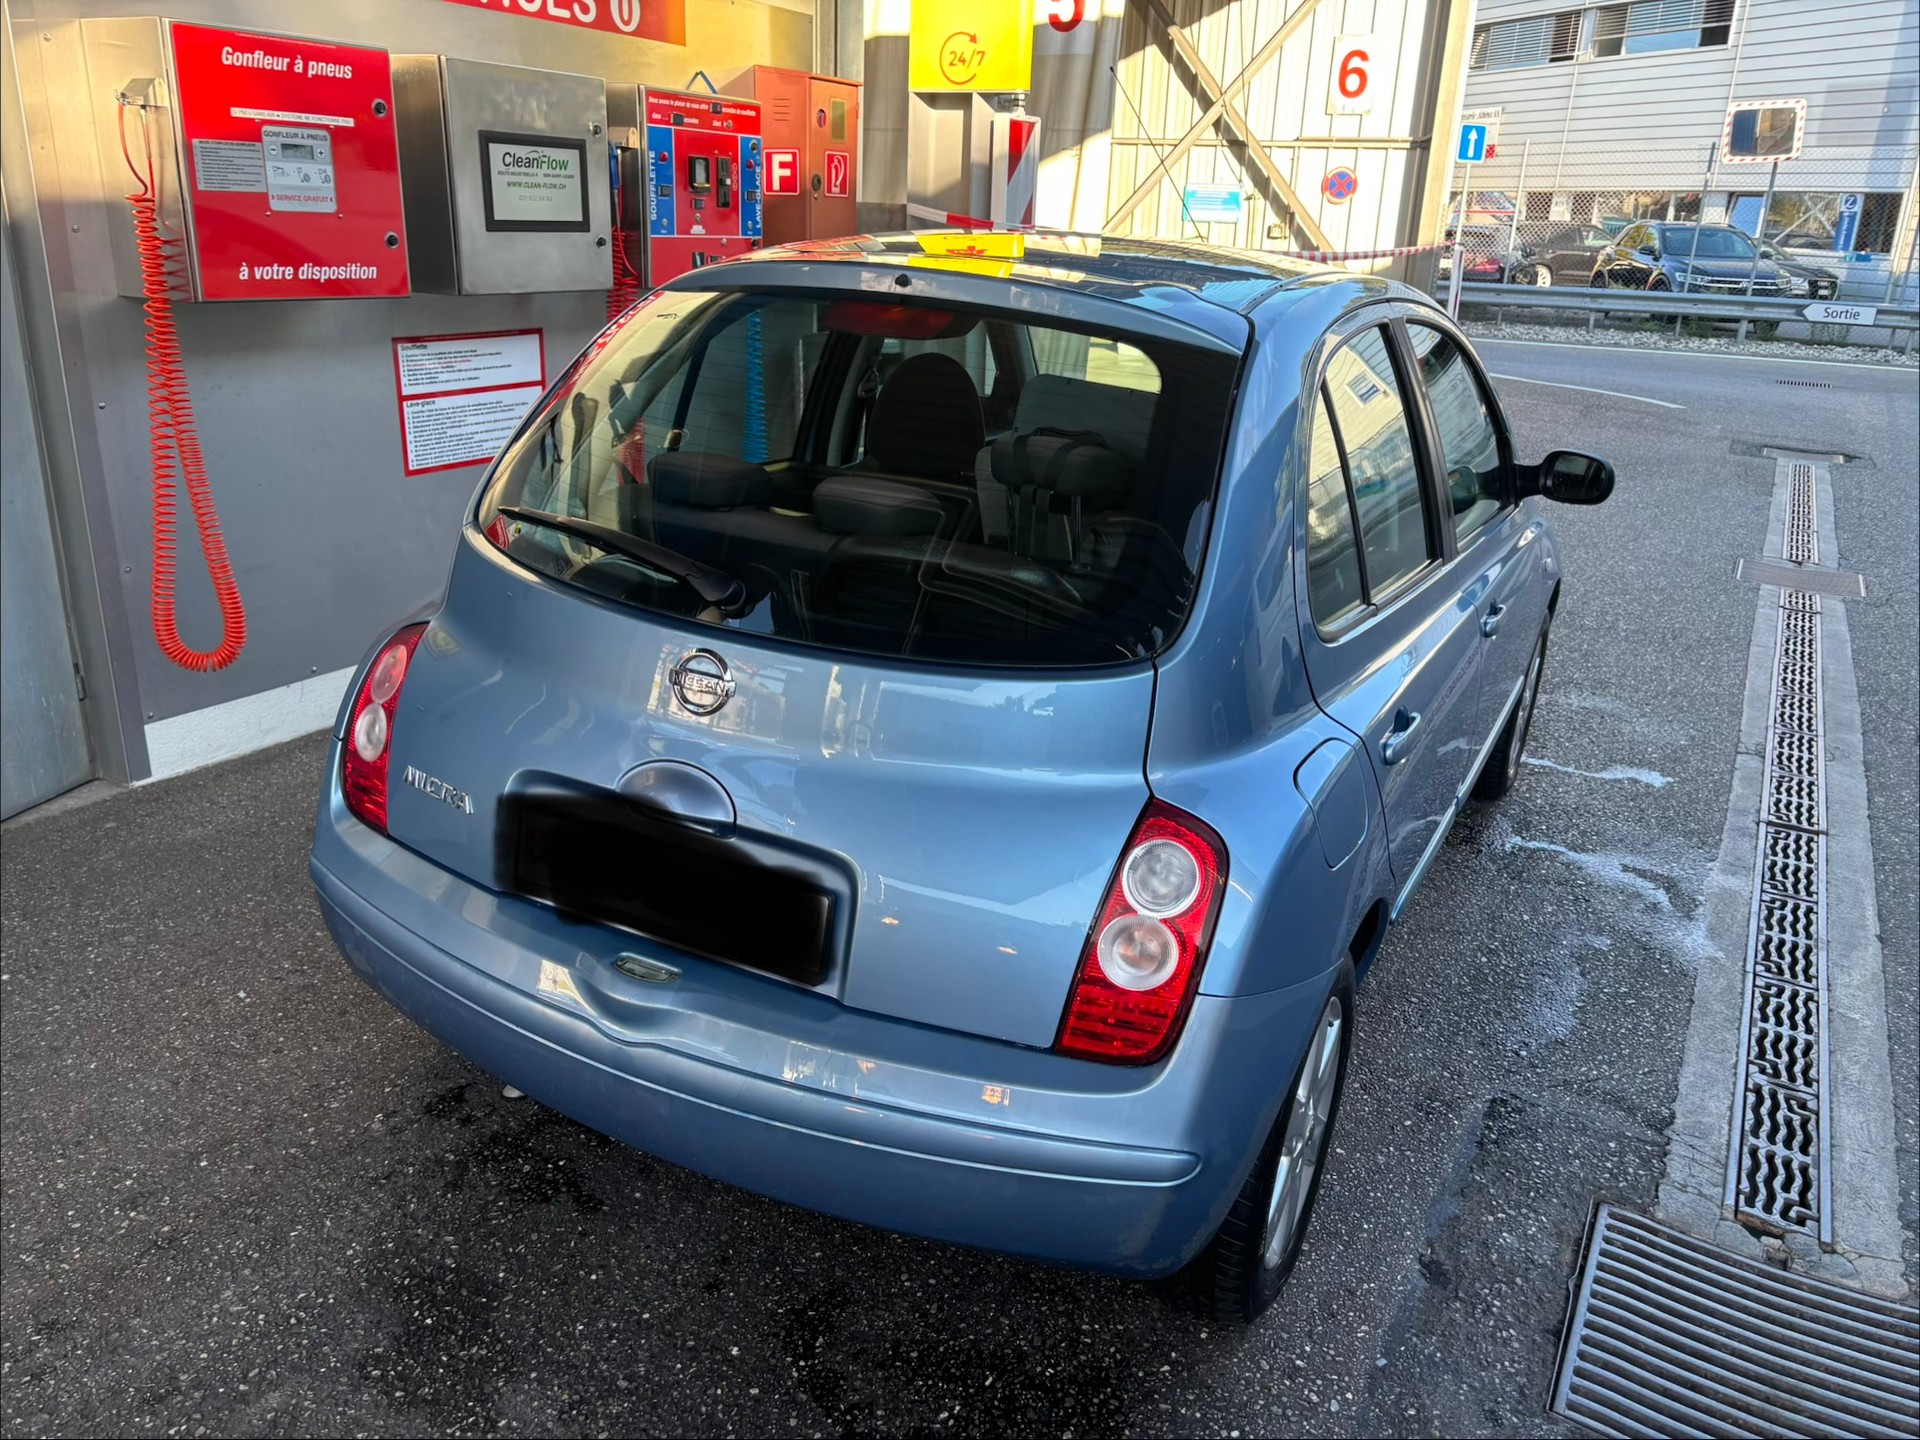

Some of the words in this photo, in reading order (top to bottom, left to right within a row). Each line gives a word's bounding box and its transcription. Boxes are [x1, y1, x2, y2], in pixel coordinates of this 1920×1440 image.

[221, 46, 290, 72] Gonfleur
[293, 54, 303, 73] à
[307, 60, 353, 79] pneus
[948, 48, 986, 69] 24/7
[1338, 49, 1369, 99] 6
[263, 130, 300, 140] GONFLEUR
[307, 133, 328, 142] PNEUS
[502, 152, 569, 171] CleanFlow
[772, 154, 792, 191] F
[507, 182, 566, 190] WWW.CLEAN-FLOW.CH
[649, 150, 657, 221] SOUFFLETTE
[276, 194, 302, 202] SERVICE
[239, 262, 249, 280] à
[254, 263, 294, 280] votre
[298, 262, 377, 283] disposition
[1823, 306, 1860, 321] Sortie
[406, 400, 436, 408] Lave-glace
[674, 668, 729, 698] NISSAN
[402, 765, 474, 815] MICRA
